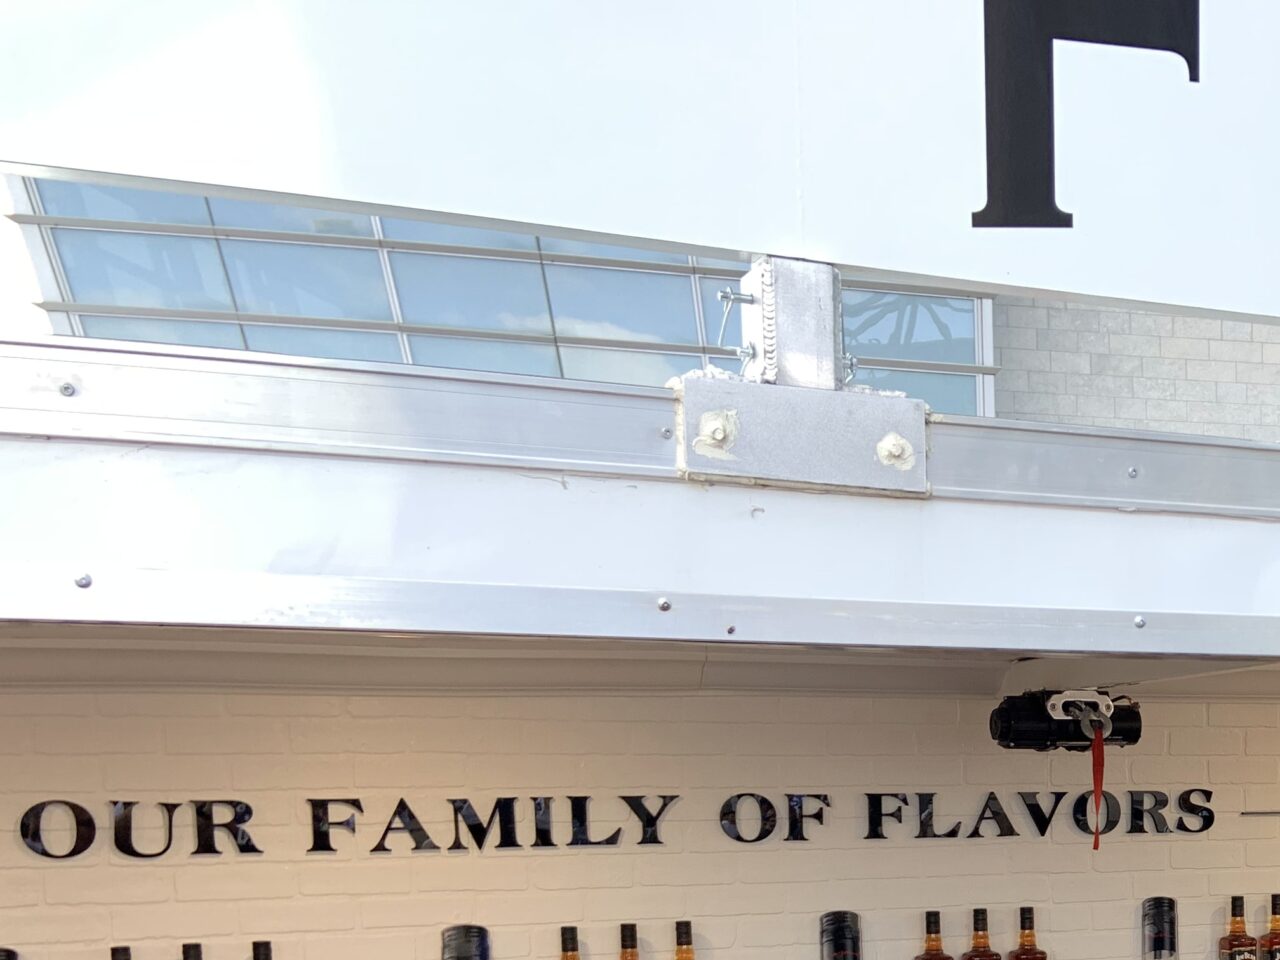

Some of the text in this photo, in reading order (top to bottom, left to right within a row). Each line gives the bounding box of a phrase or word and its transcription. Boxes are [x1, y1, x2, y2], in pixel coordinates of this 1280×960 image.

[20, 787, 1215, 858] OUR FAMILY OF FLAVORS
